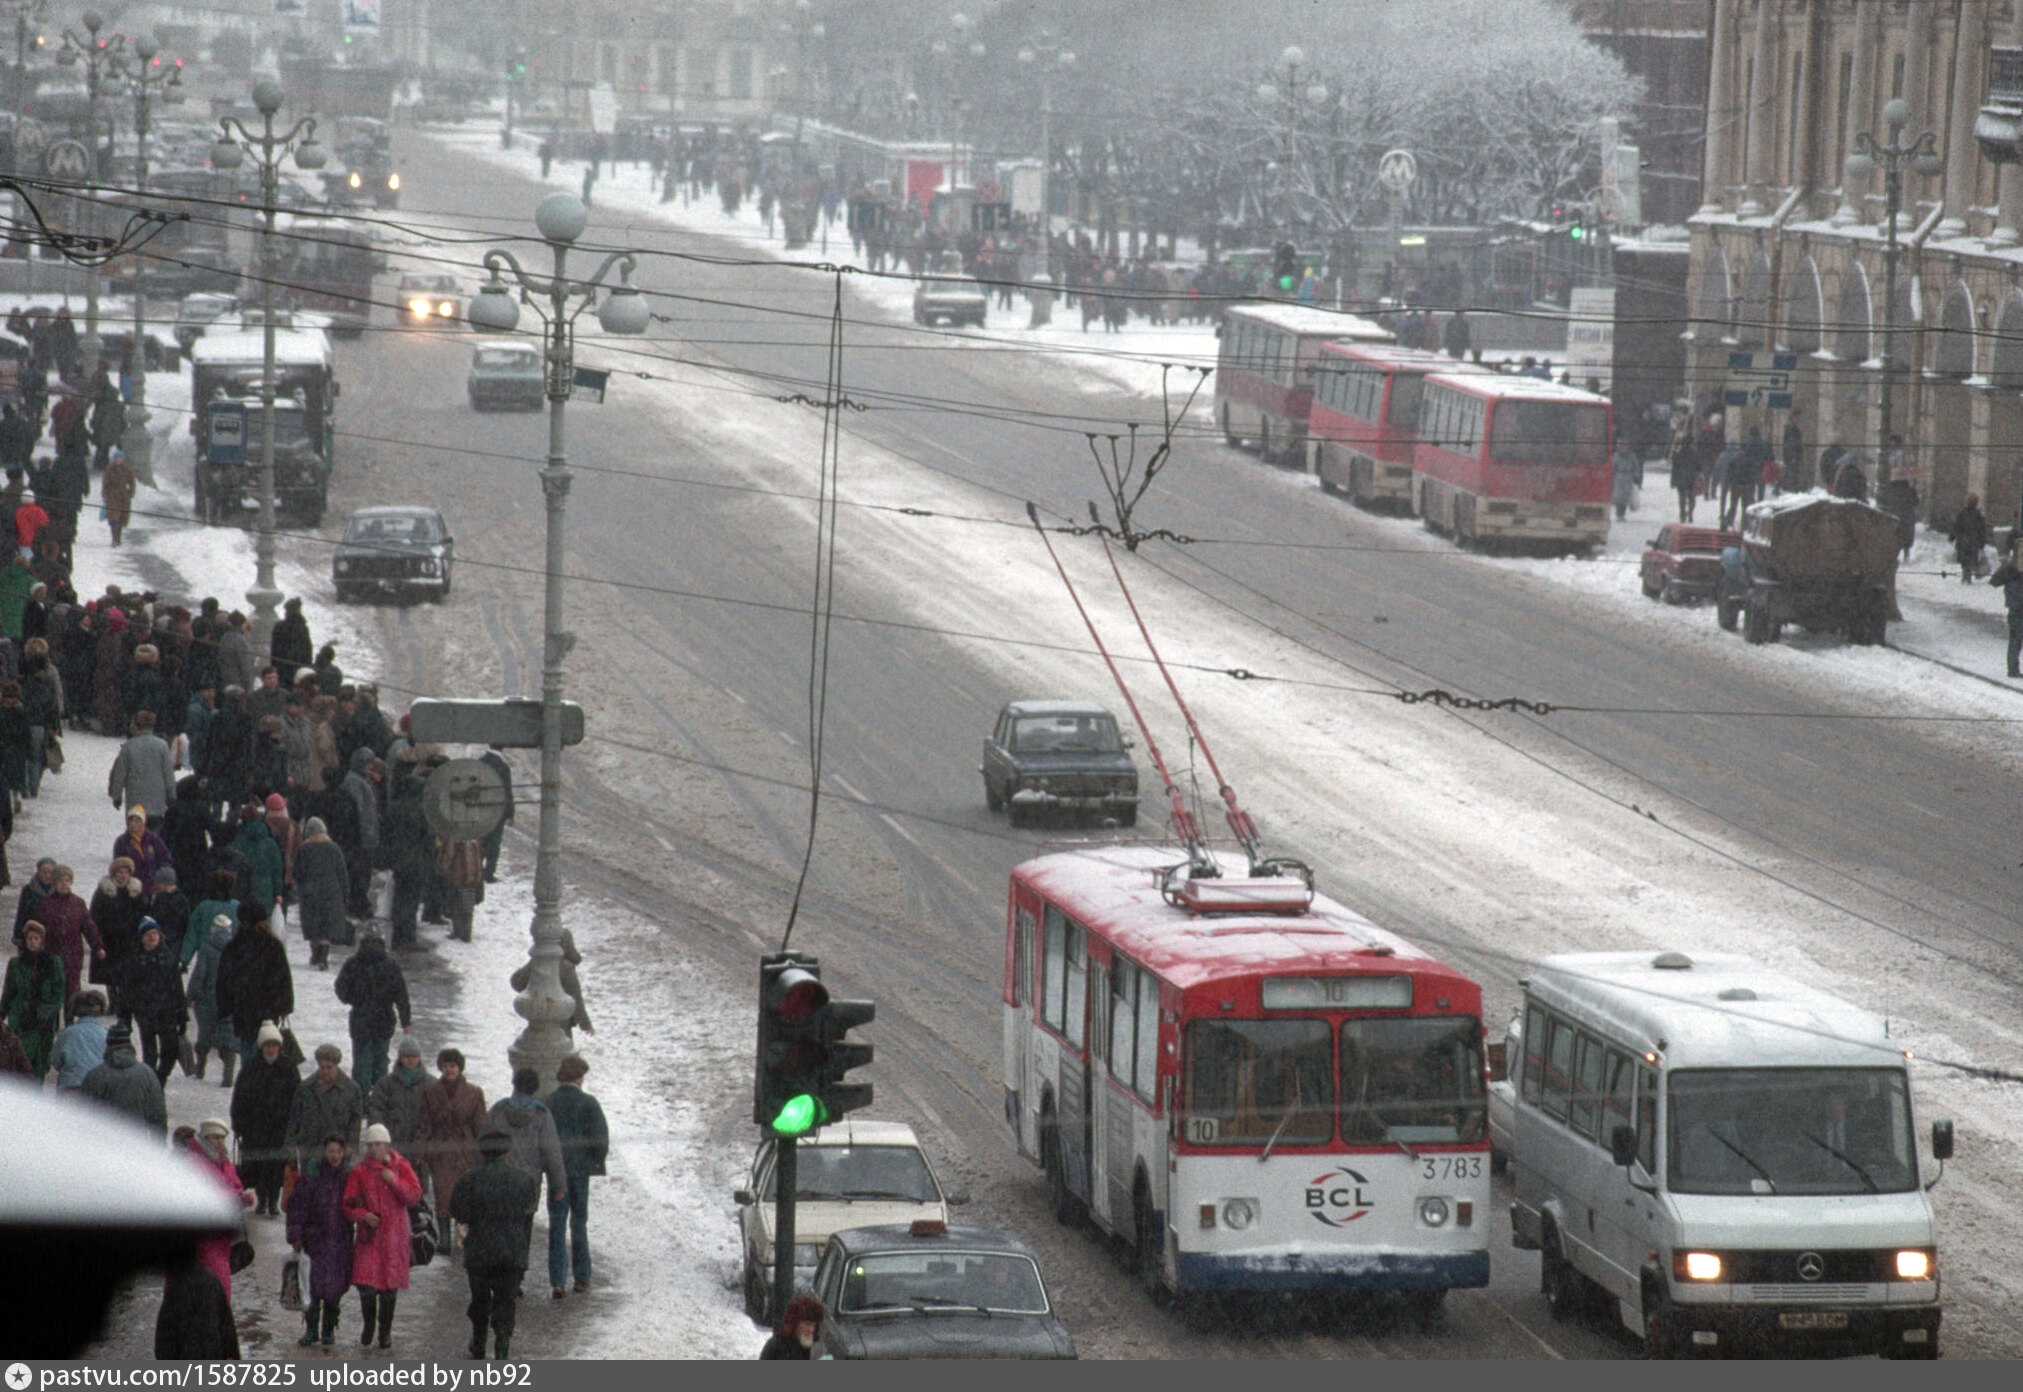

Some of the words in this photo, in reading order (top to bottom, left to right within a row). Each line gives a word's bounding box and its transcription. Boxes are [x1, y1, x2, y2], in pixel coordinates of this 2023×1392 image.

[50, 146, 85, 175] М
[1382, 155, 1414, 181] М
[1323, 981, 1344, 1003] 10
[1193, 1119, 1214, 1141] 10
[1422, 1157, 1482, 1180] 3783
[1305, 1187, 1375, 1208] BCL
